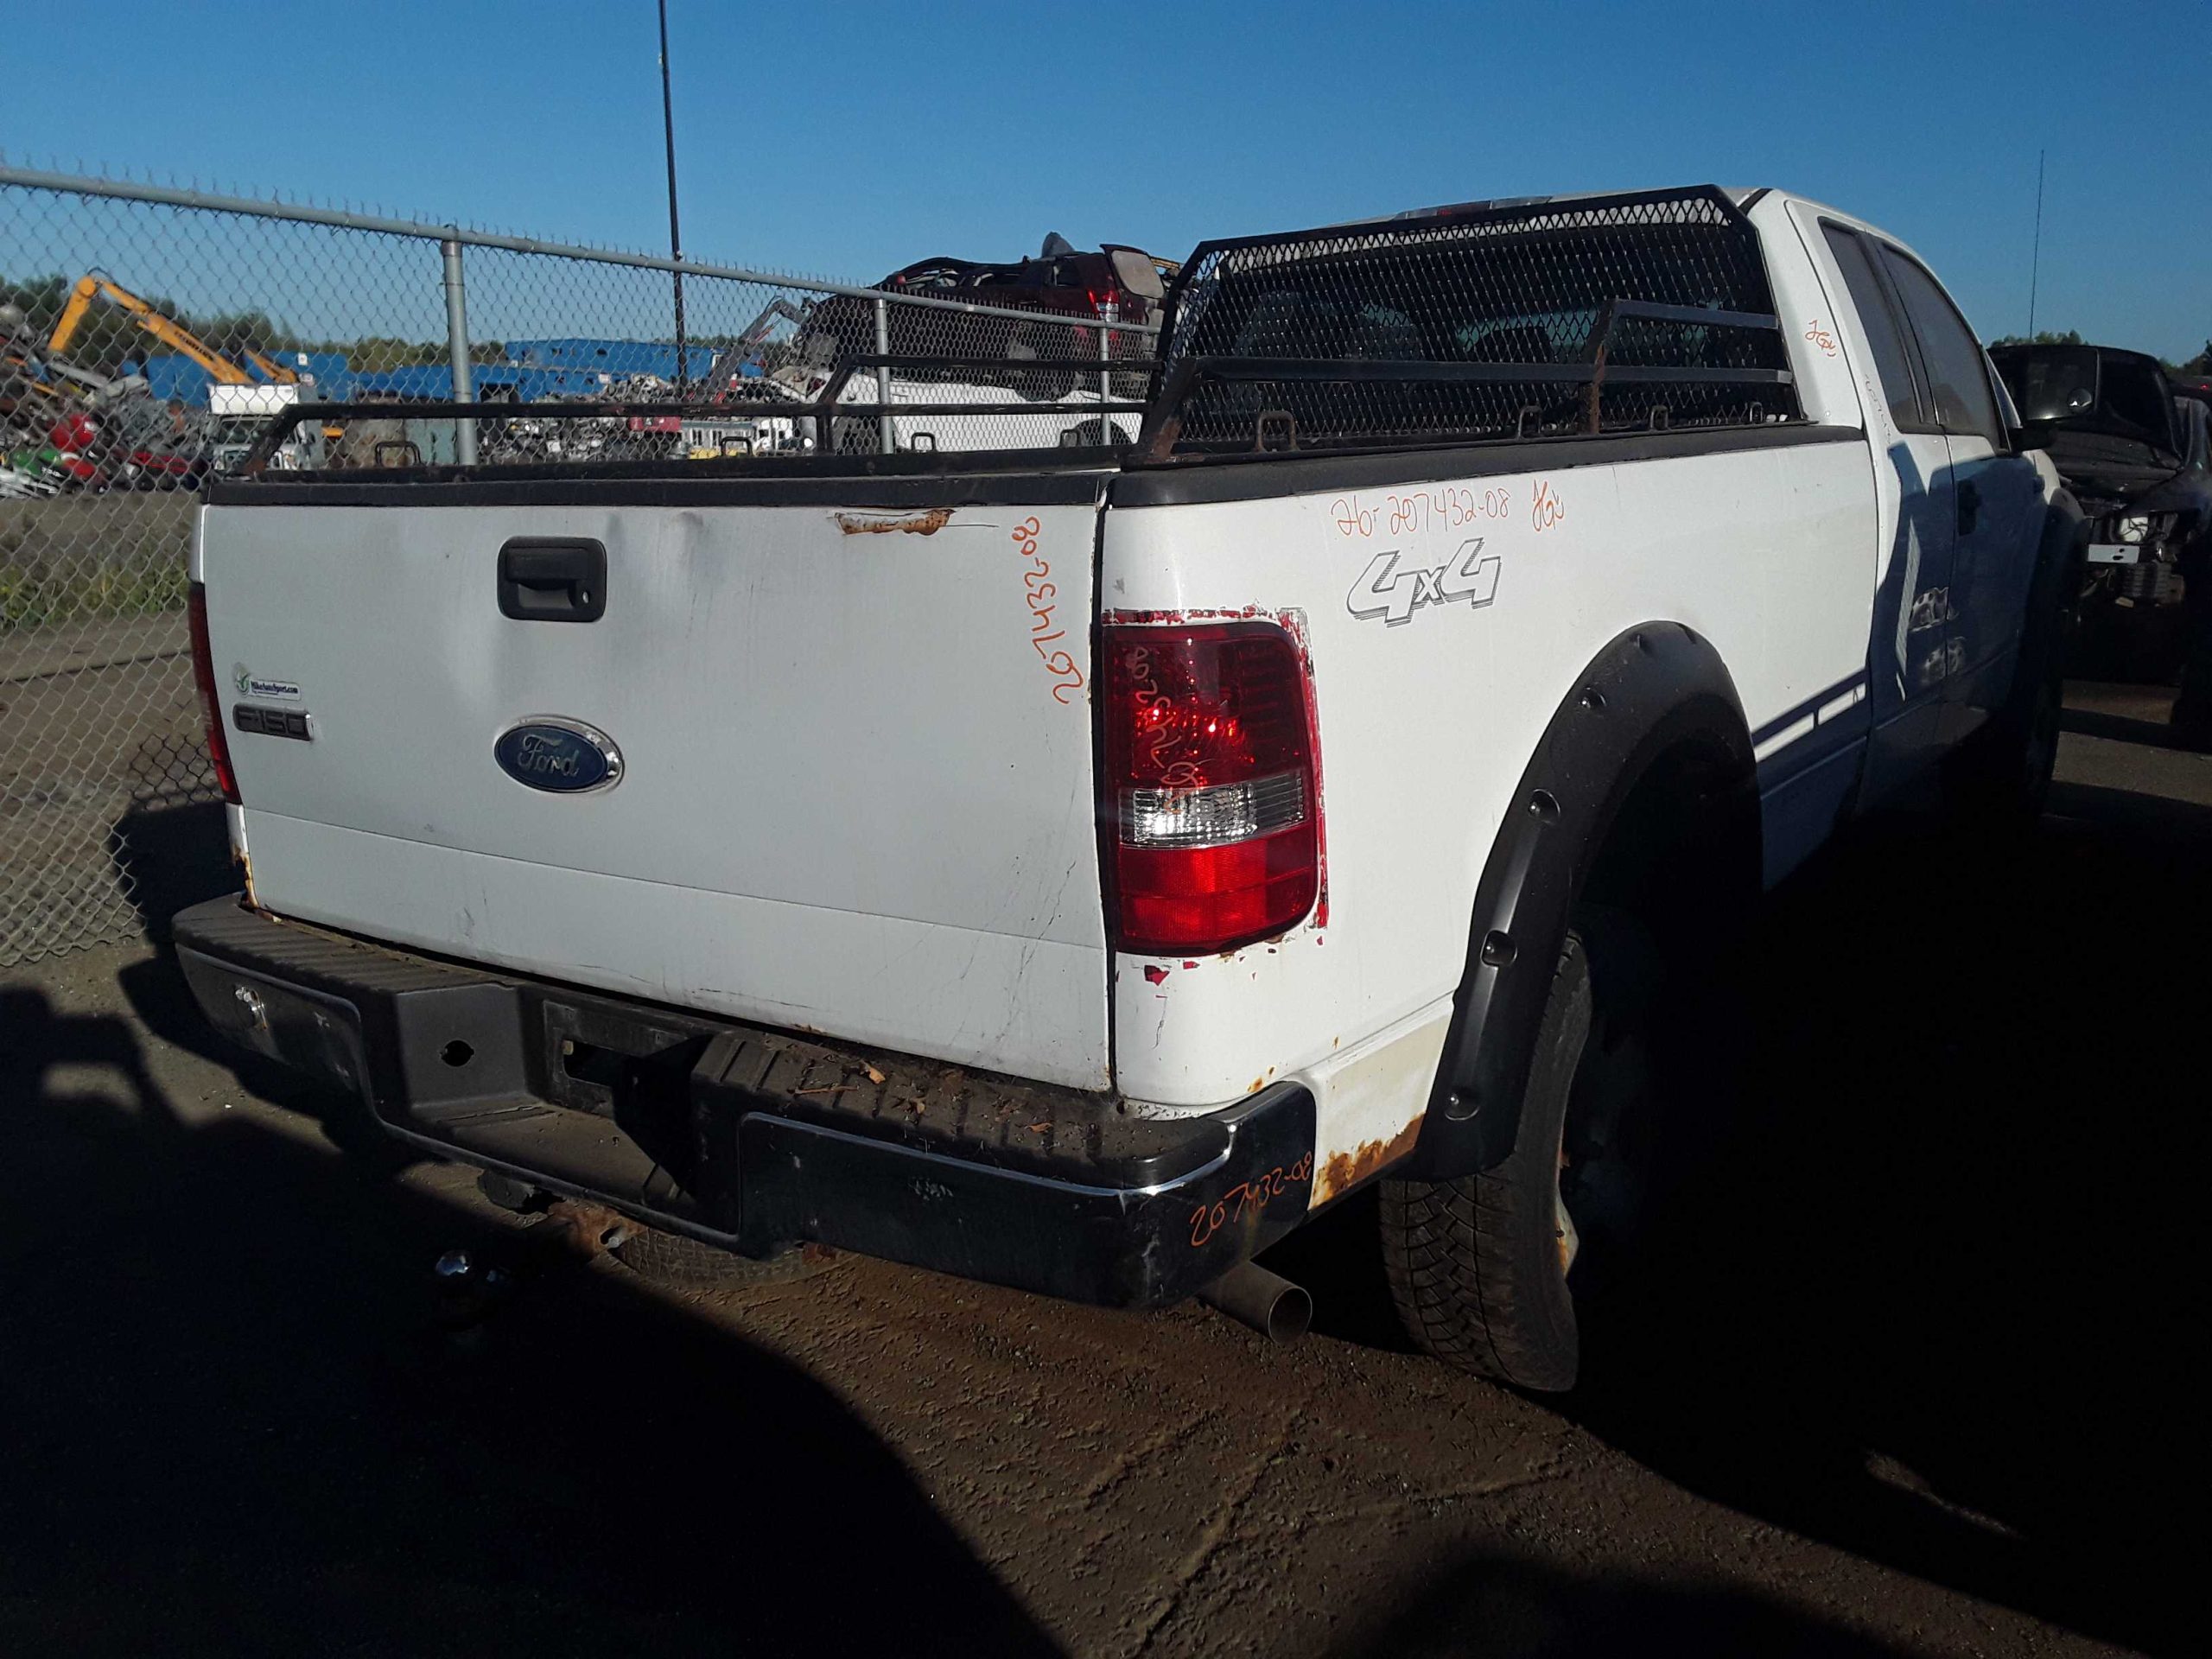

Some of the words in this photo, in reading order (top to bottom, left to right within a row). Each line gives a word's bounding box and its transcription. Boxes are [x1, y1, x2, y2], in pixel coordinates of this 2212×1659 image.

[1012, 516, 1084, 704] 207432-08
[1347, 537, 1502, 628] 4x4
[518, 734, 581, 777] Ford
